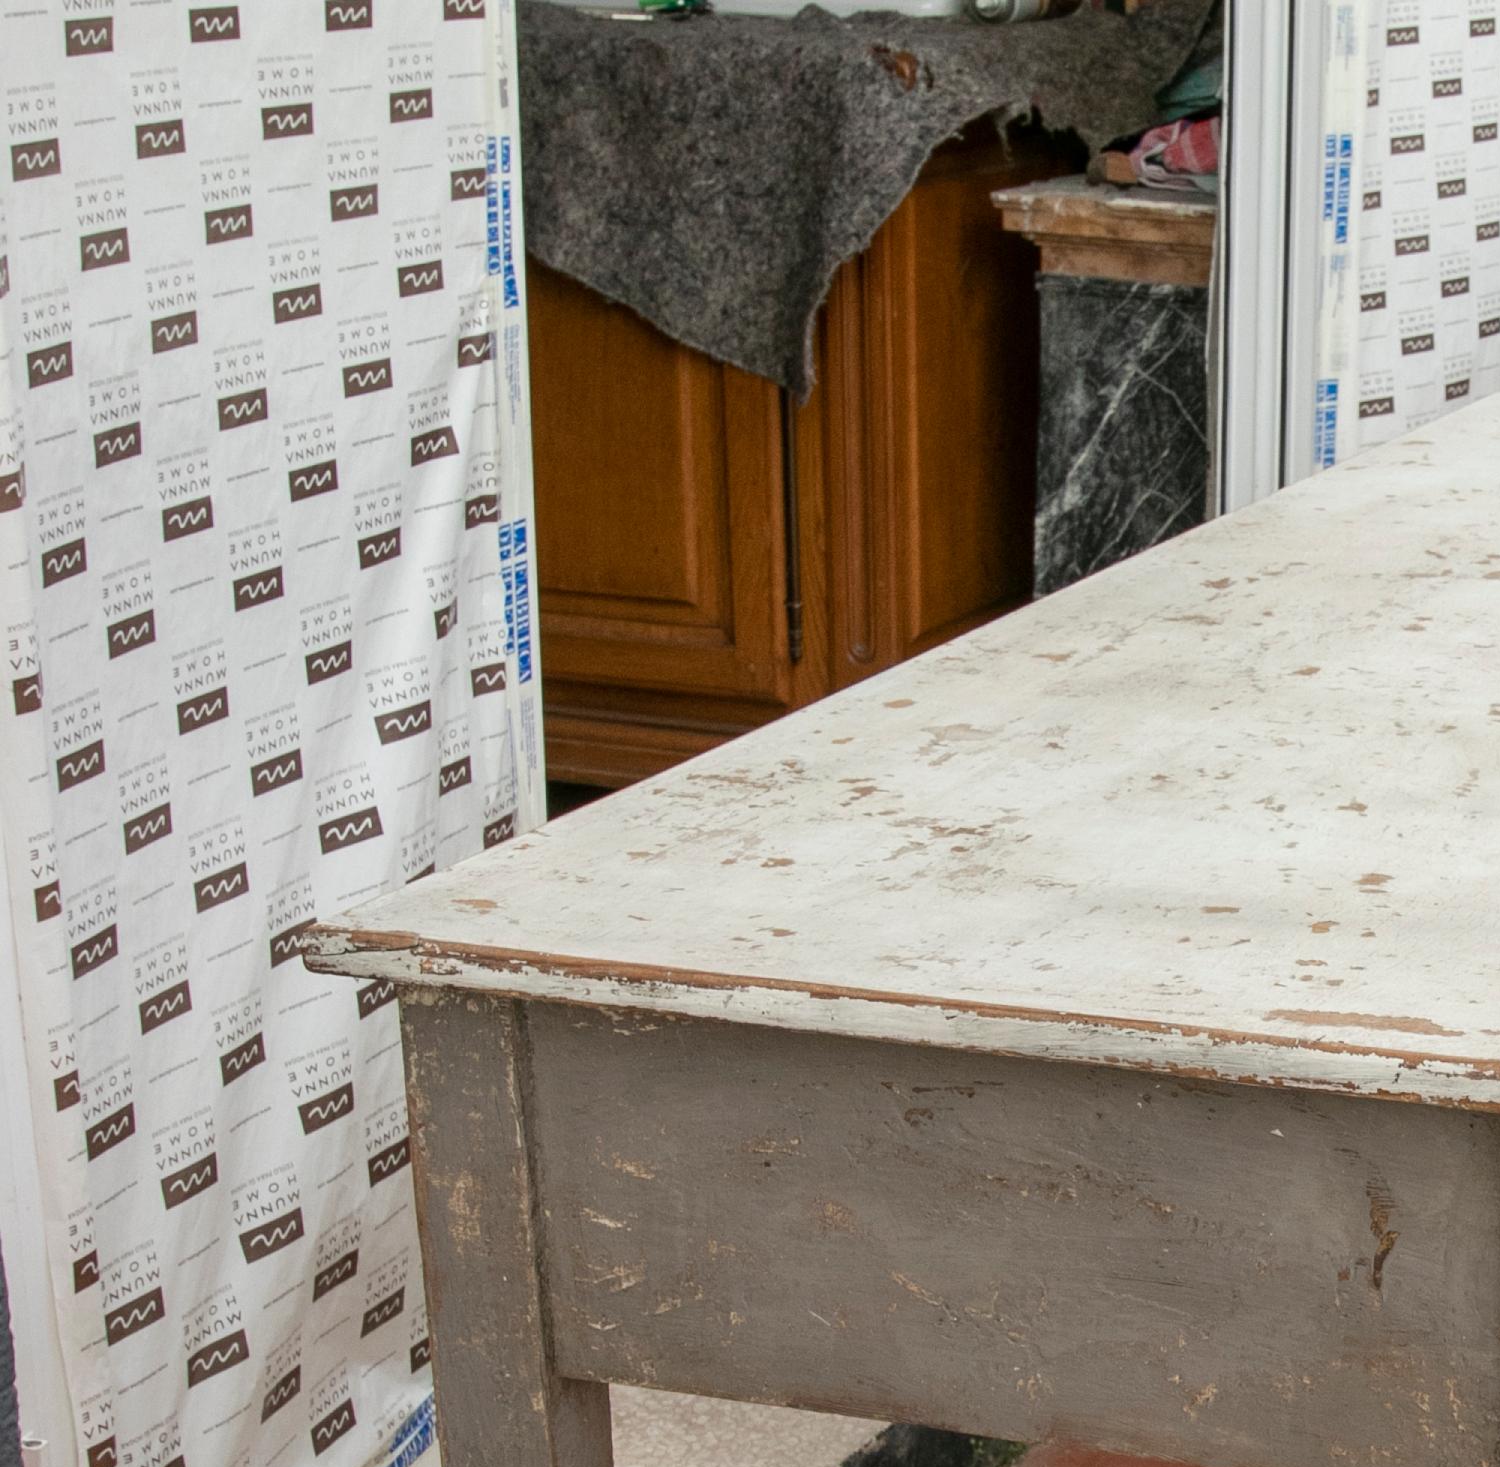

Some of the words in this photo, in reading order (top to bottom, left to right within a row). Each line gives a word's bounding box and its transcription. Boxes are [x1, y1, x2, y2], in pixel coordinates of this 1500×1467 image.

[388, 54, 433, 66] HOME
[258, 67, 313, 81] HOME
[388, 70, 433, 83] MUNNA
[132, 80, 180, 97] HOME
[258, 84, 314, 99] MUNNA
[8, 96, 55, 116] HOME
[133, 99, 181, 116] MUNNA
[8, 117, 58, 136] MUNNA
[327, 149, 379, 165] HOME
[201, 168, 250, 185] HOME
[328, 166, 379, 182] MUNNA
[75, 189, 125, 208] HOME
[202, 185, 251, 203] MUNNA
[77, 207, 127, 227] MUNNA
[394, 226, 441, 243] HOME
[268, 248, 319, 267] HOME
[395, 242, 442, 259] MUNNA
[146, 273, 195, 293] HOME
[270, 265, 320, 284] MUNNA
[22, 302, 70, 324] HOME
[148, 291, 197, 311] MUNNA
[24, 320, 72, 343] MUNNA
[338, 323, 389, 343] HOME
[339, 339, 390, 360] MUNNA
[214, 352, 264, 373] HOME
[215, 369, 266, 390] MUNNA
[89, 384, 140, 407] HOME
[90, 401, 141, 425] MUNNA
[409, 408, 451, 429] MUNNA
[284, 424, 334, 446] HOME
[285, 441, 336, 464] MUNNA
[158, 459, 208, 483] HOME
[159, 476, 210, 501] MUNNA
[38, 499, 84, 526] HOME
[354, 493, 402, 516] HOME
[39, 517, 86, 544] MUNNA
[355, 509, 402, 532] MUNNA
[229, 531, 280, 555] HOME
[230, 547, 282, 572] MUNNA
[102, 572, 151, 599] HOME
[103, 589, 153, 617] MUNNA
[301, 606, 351, 632] HOME
[514, 560, 533, 685] FABRICA
[302, 621, 352, 647] MUNNA
[173, 650, 225, 678] HOME
[174, 667, 227, 695] MUNNA
[367, 667, 429, 693] HOME
[369, 681, 430, 708] MUNNA
[52, 702, 100, 733] HOME
[246, 714, 298, 742] HOME
[53, 720, 102, 750] MUNNA
[248, 730, 300, 758] MUNNA
[119, 766, 168, 797] HOME
[315, 773, 370, 802] HOME
[121, 783, 169, 814] MUNNA
[316, 788, 375, 817] MUNNA
[189, 827, 243, 858] HOME
[190, 843, 245, 874] MUNNA
[267, 884, 312, 916] HOME
[68, 904, 118, 940] MUNNA
[267, 899, 315, 931] MUNNA
[135, 945, 186, 979] HOME
[136, 960, 188, 995] MUNNA
[216, 1014, 263, 1048] MUNNA
[288, 1050, 350, 1083] HOME
[292, 1064, 351, 1098] MUNNA
[83, 1083, 133, 1121] MUNNA
[153, 1118, 214, 1155] HOME
[156, 1133, 215, 1171] MUNNA
[232, 1174, 297, 1211] HOME
[234, 1189, 300, 1226] MUNNA
[185, 1311, 242, 1352] MUNNA
